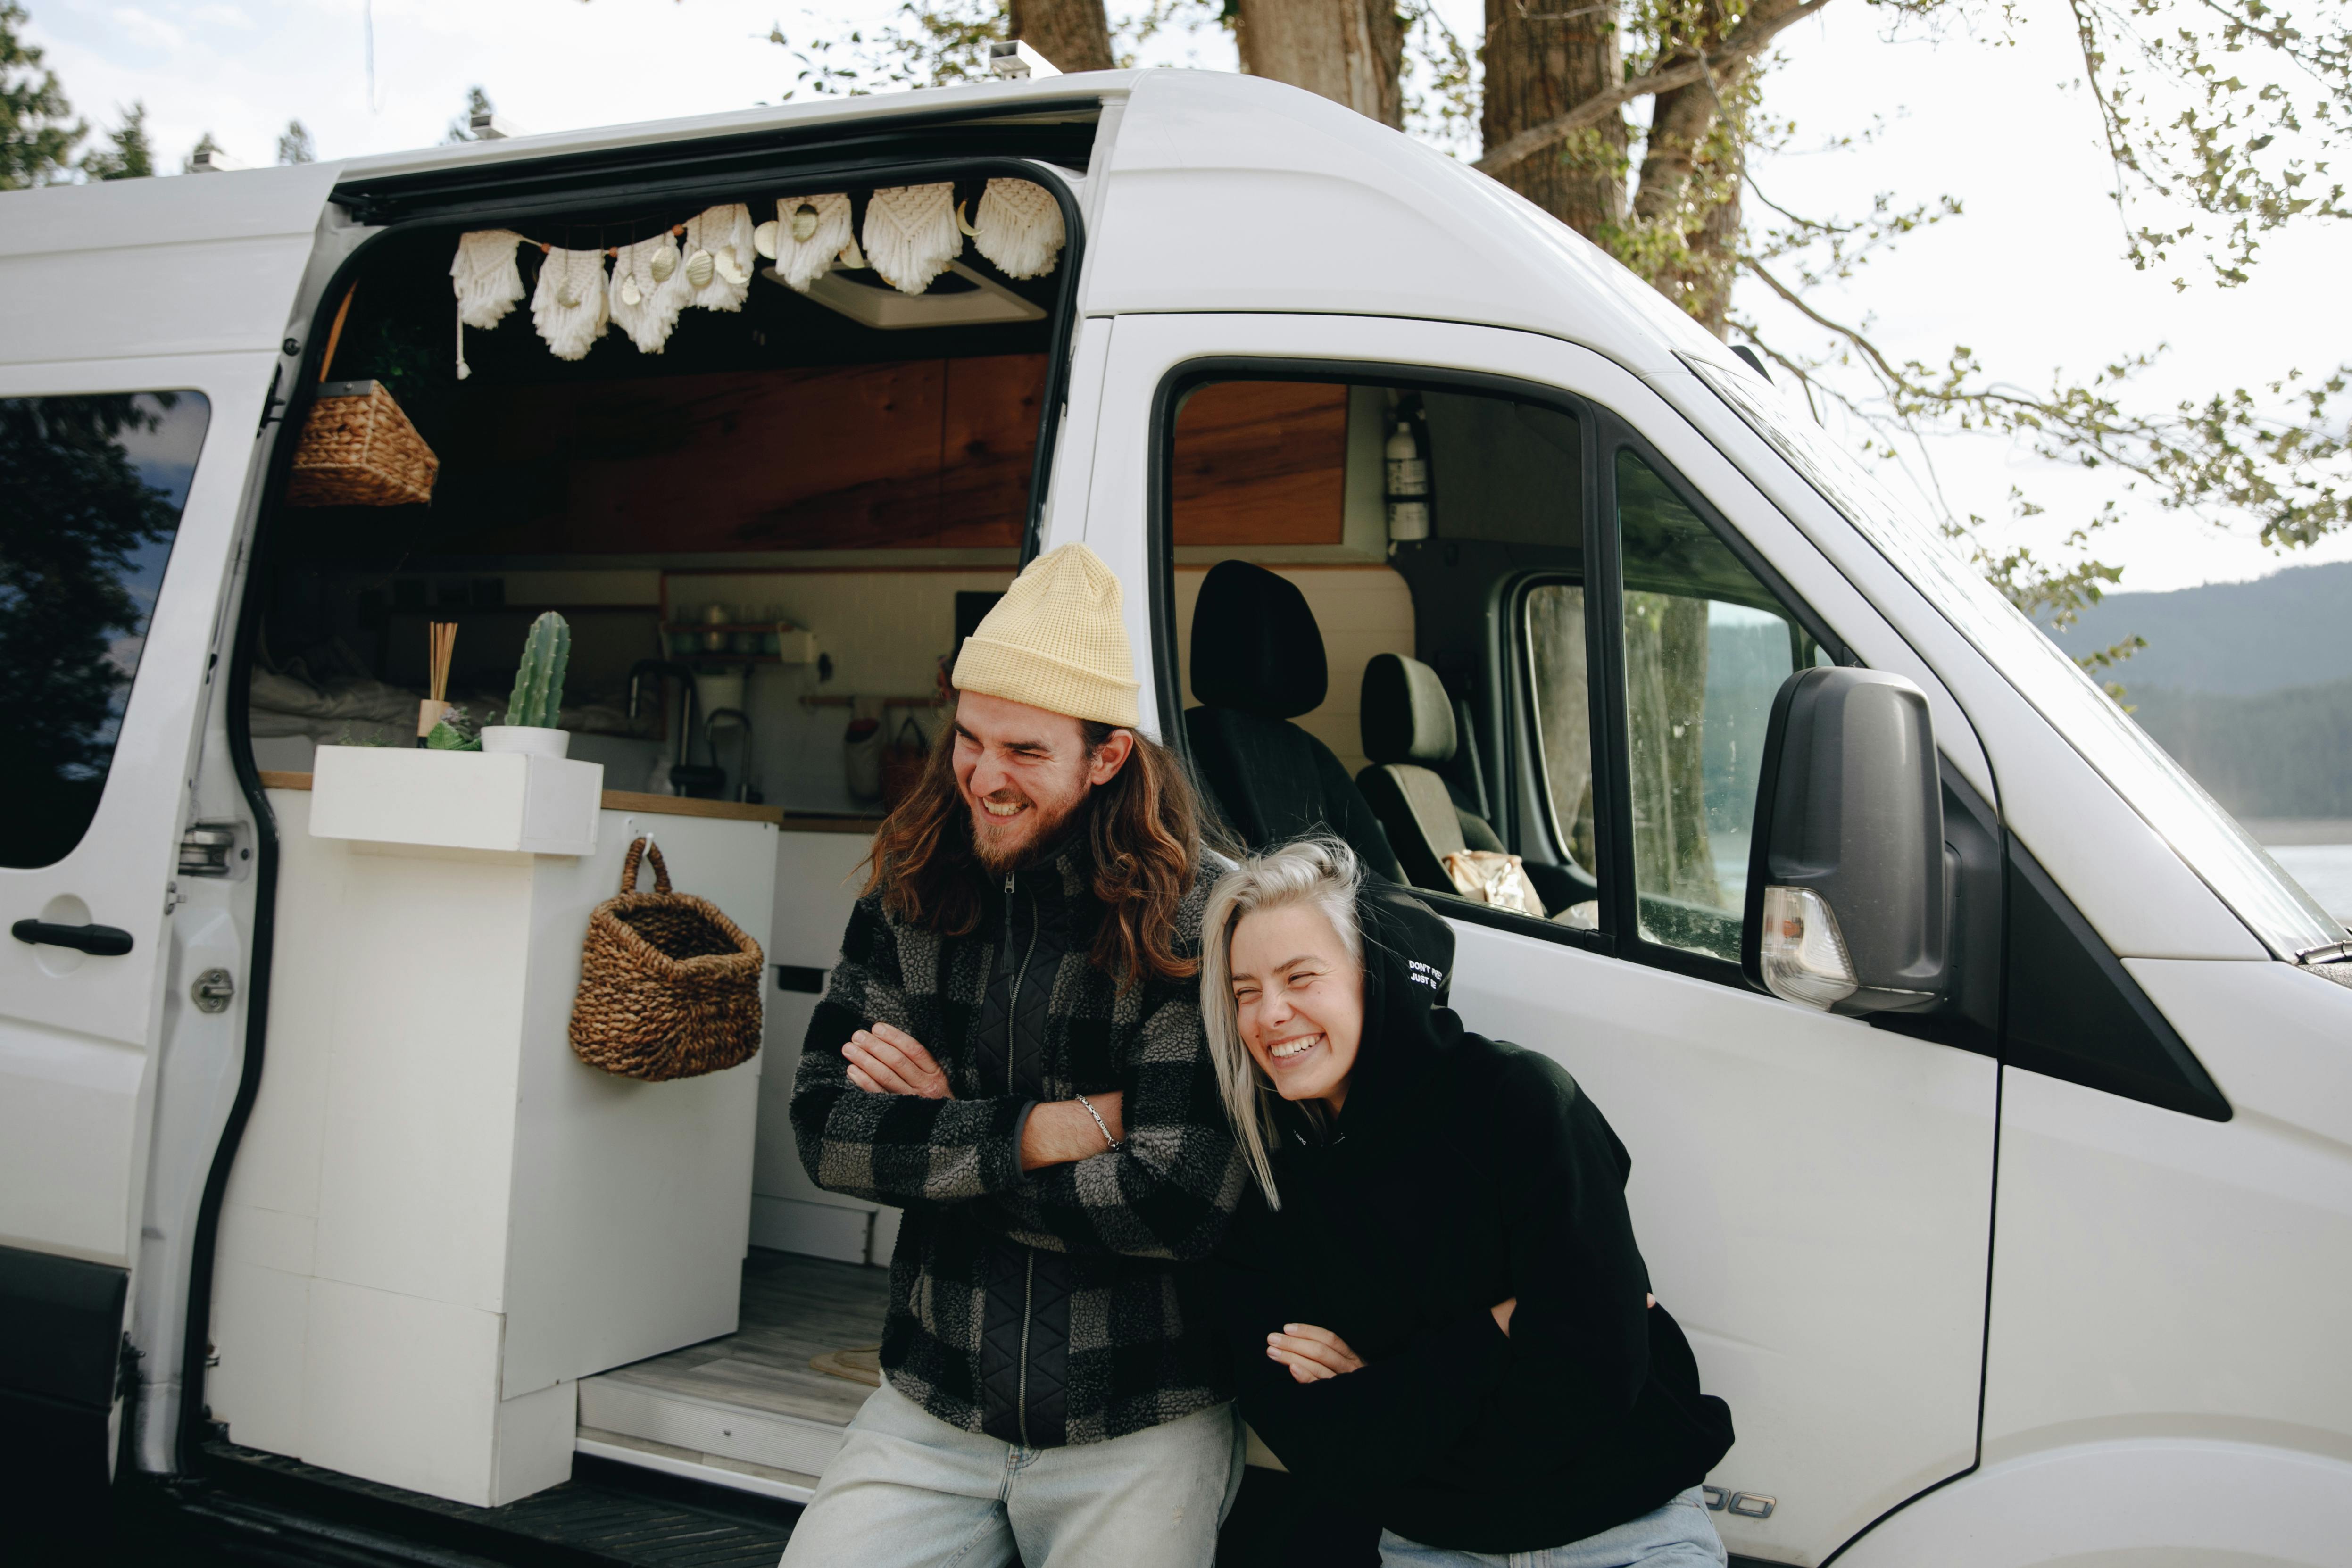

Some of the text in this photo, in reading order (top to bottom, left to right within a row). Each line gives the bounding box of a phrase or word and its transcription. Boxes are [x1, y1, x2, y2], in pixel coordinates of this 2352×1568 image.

[1409, 960, 1442, 981] DON'T PRE
[1411, 972, 1429, 985] JUST
